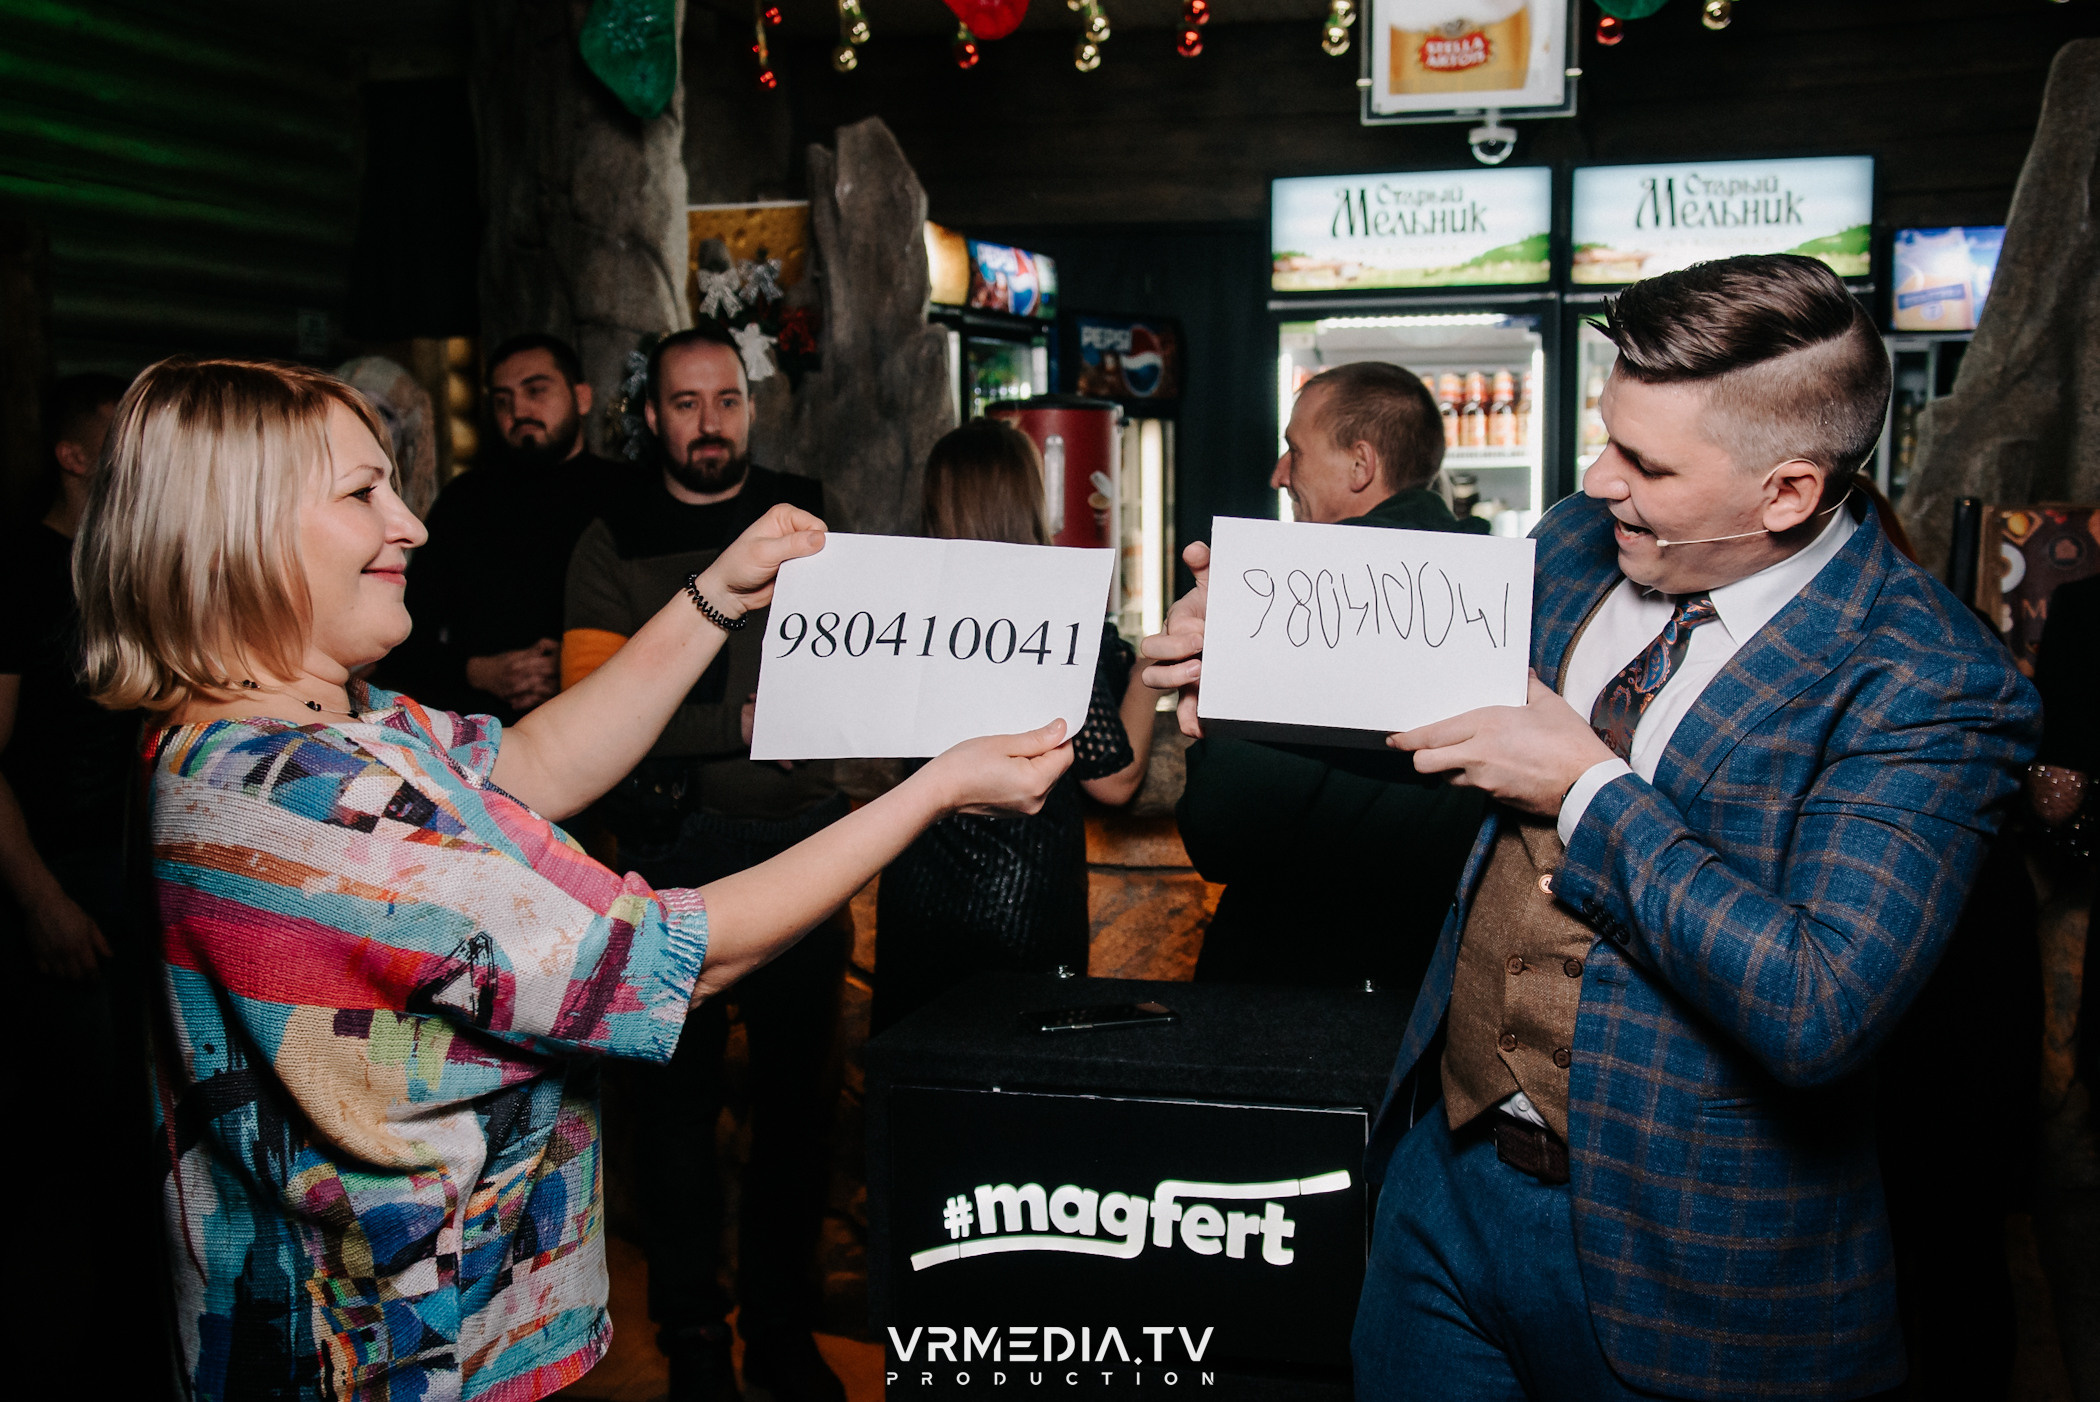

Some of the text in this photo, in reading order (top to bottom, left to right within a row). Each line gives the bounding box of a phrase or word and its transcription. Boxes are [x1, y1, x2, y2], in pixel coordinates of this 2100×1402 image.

[1635, 177, 1804, 229] Мельник
[1684, 172, 1779, 197] Старый
[1331, 188, 1488, 238] Мельник
[1081, 325, 1133, 351] PEPSI
[776, 611, 1080, 666] 980410041
[910, 1170, 1351, 1271] #magfert
